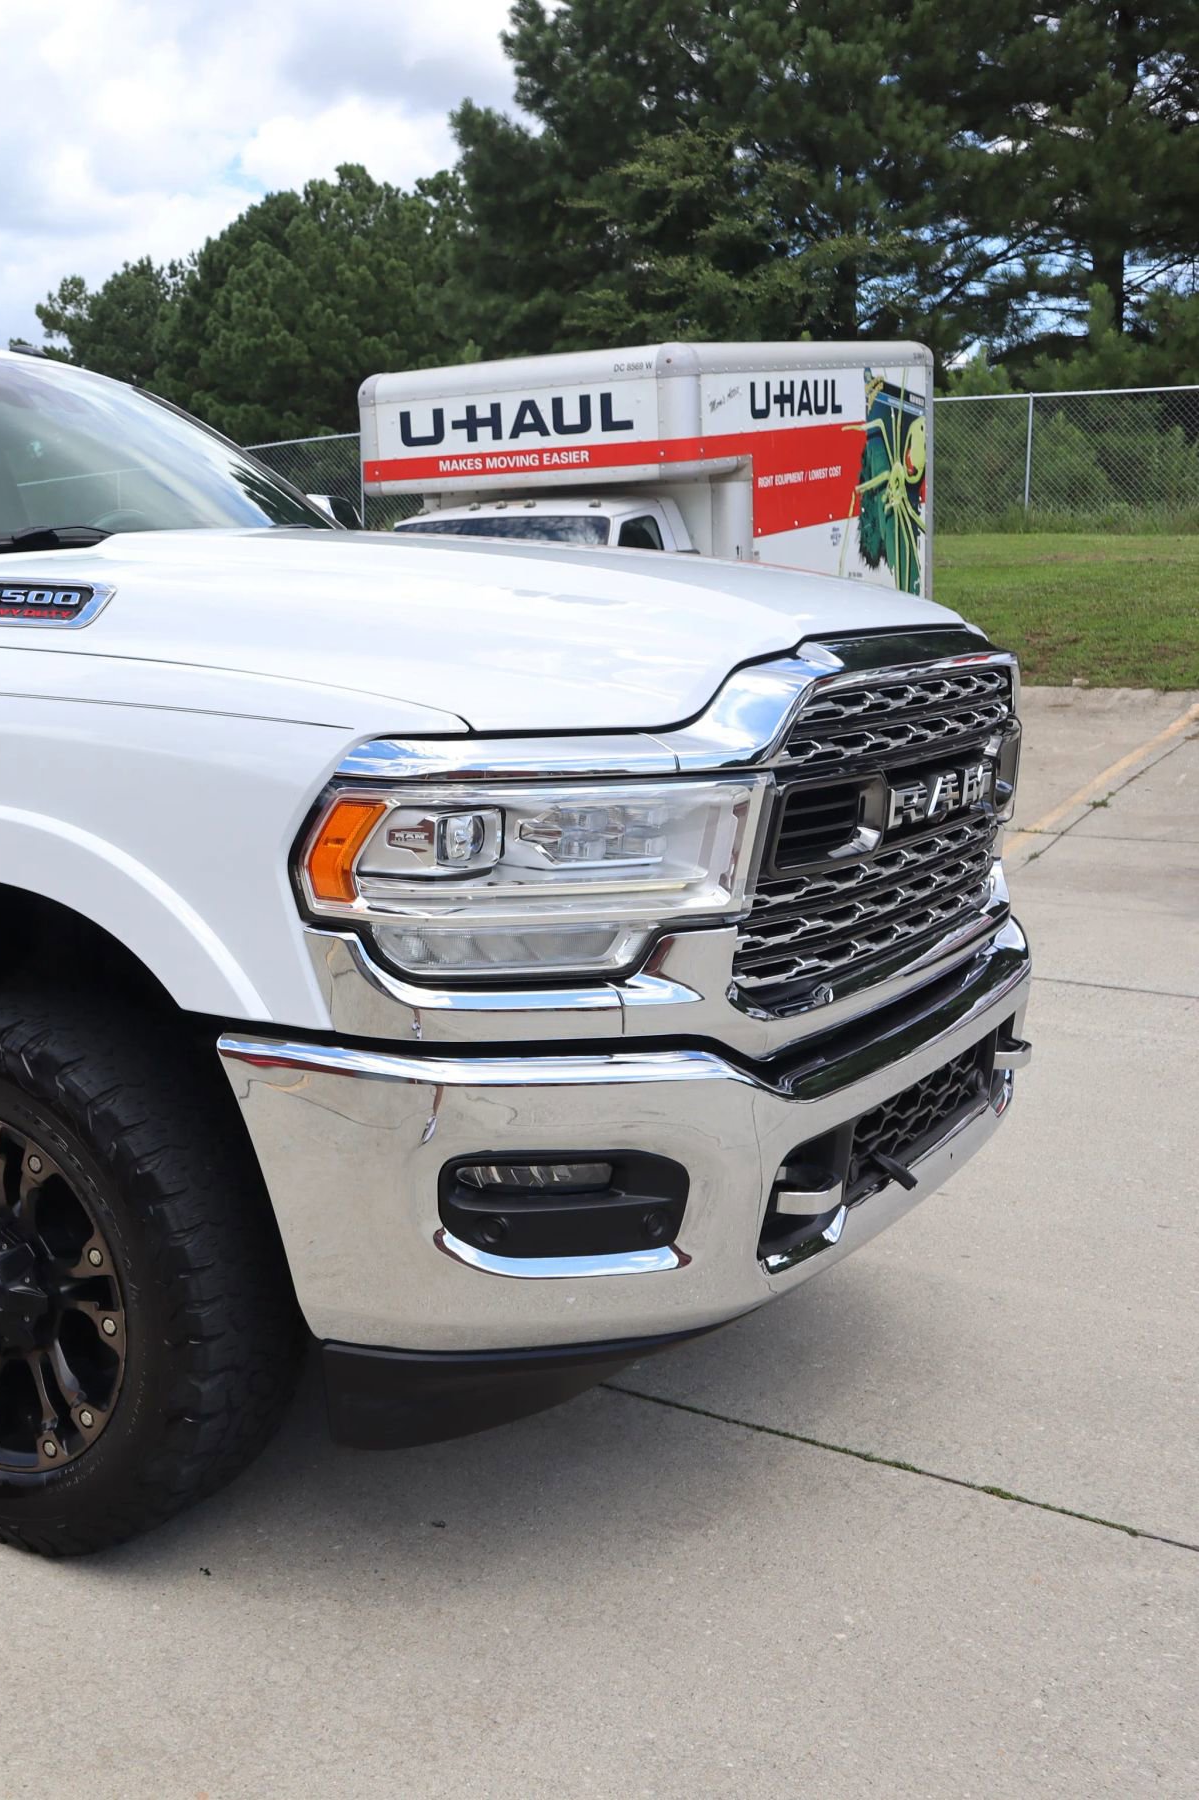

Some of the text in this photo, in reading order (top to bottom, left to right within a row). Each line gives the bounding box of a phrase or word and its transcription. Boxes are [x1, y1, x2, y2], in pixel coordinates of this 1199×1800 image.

[613, 363, 625, 373] DC
[645, 361, 653, 369] W
[750, 379, 842, 419] U-HAUL
[399, 391, 634, 448] U-HAUL
[438, 450, 590, 472] MAKES MOVING EASIER
[757, 475, 774, 489] RIGHT
[775, 470, 804, 486] EQUIPMENT
[808, 466, 828, 481] LOWEST
[828, 465, 842, 478] COST
[22, 609, 74, 618] DUTY
[887, 761, 994, 831] RAM
